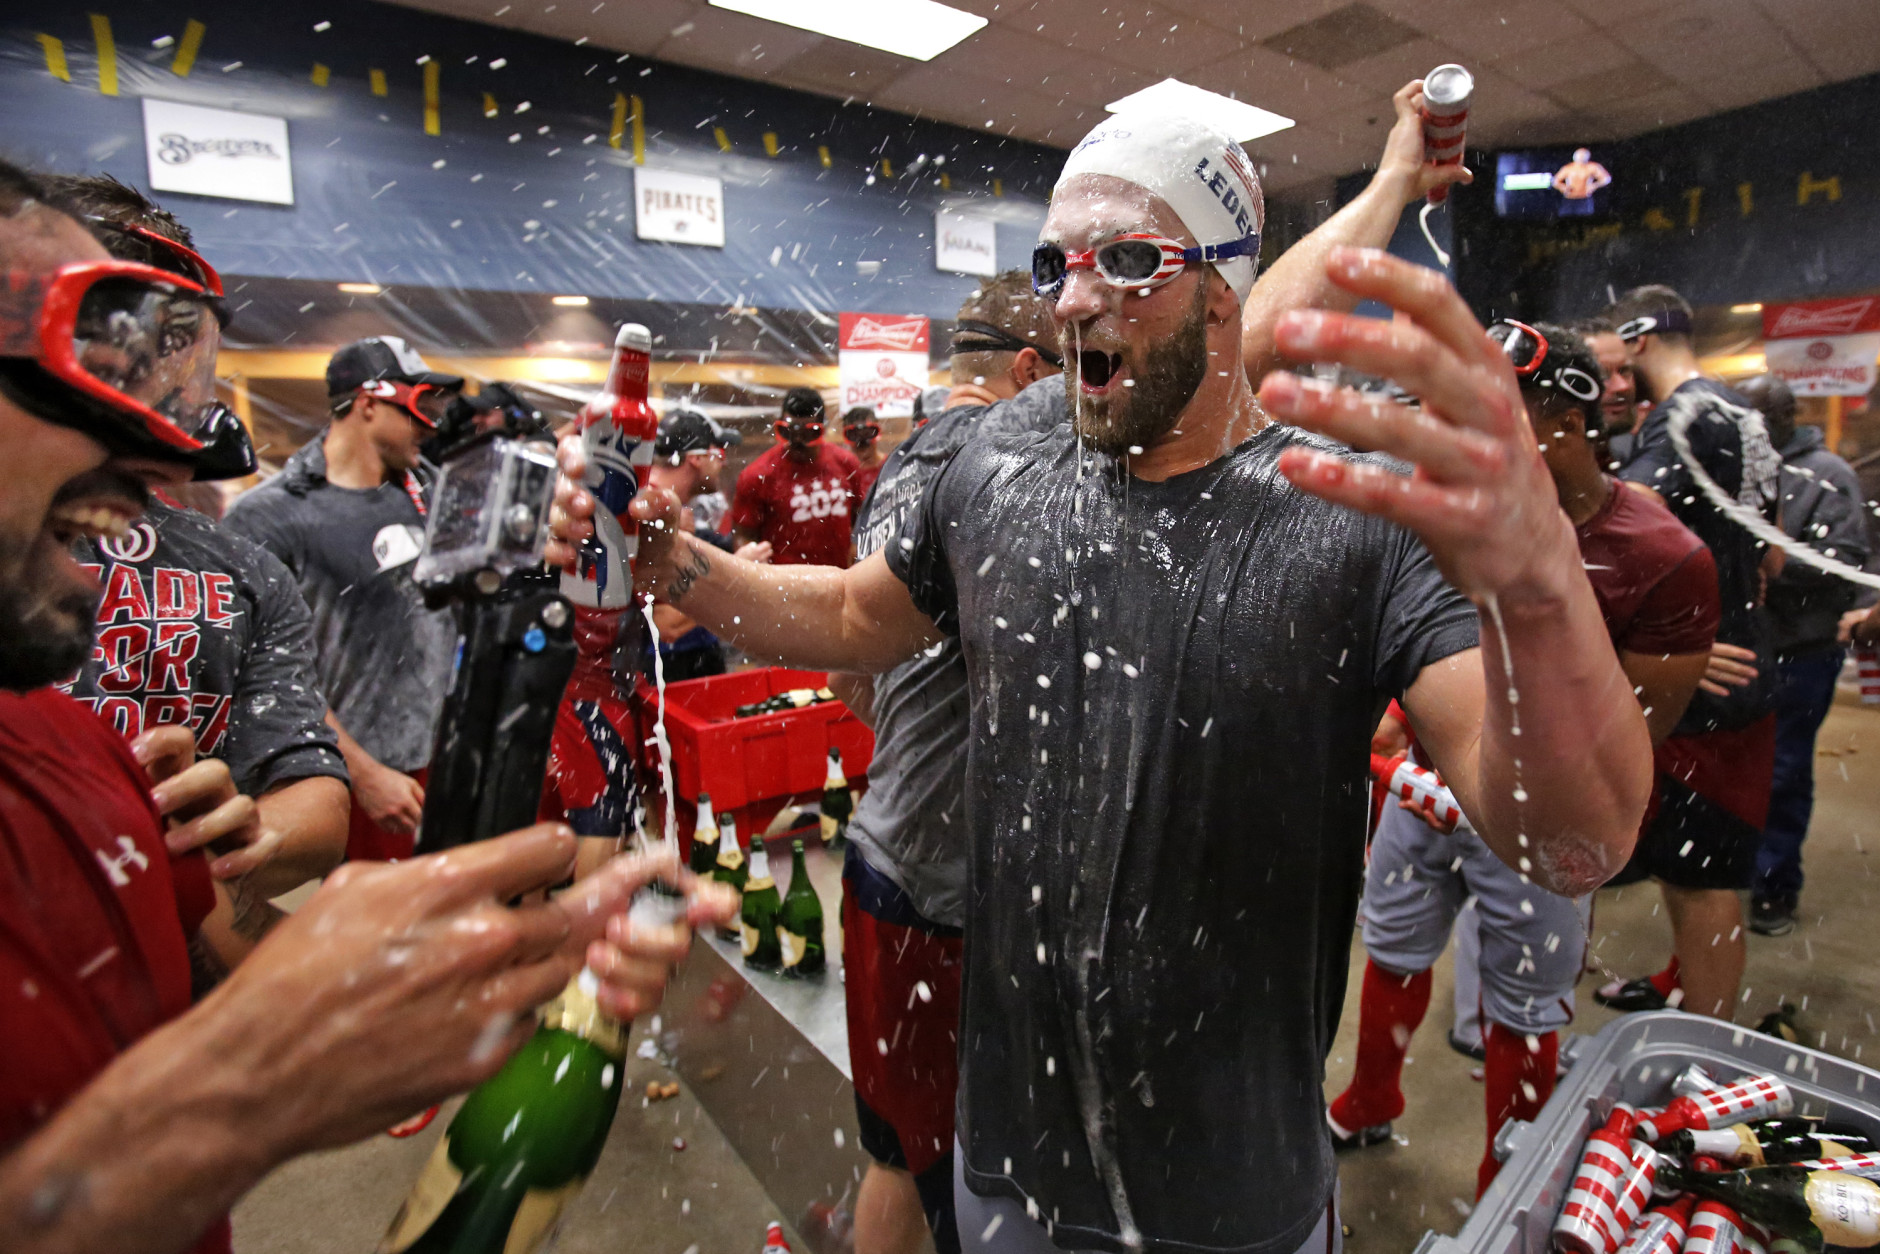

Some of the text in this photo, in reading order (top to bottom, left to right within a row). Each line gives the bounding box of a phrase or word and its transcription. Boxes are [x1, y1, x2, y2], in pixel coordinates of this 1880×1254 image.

[643, 187, 717, 224] PIRATES
[789, 487, 848, 523] 202
[80, 561, 234, 630] ADE
